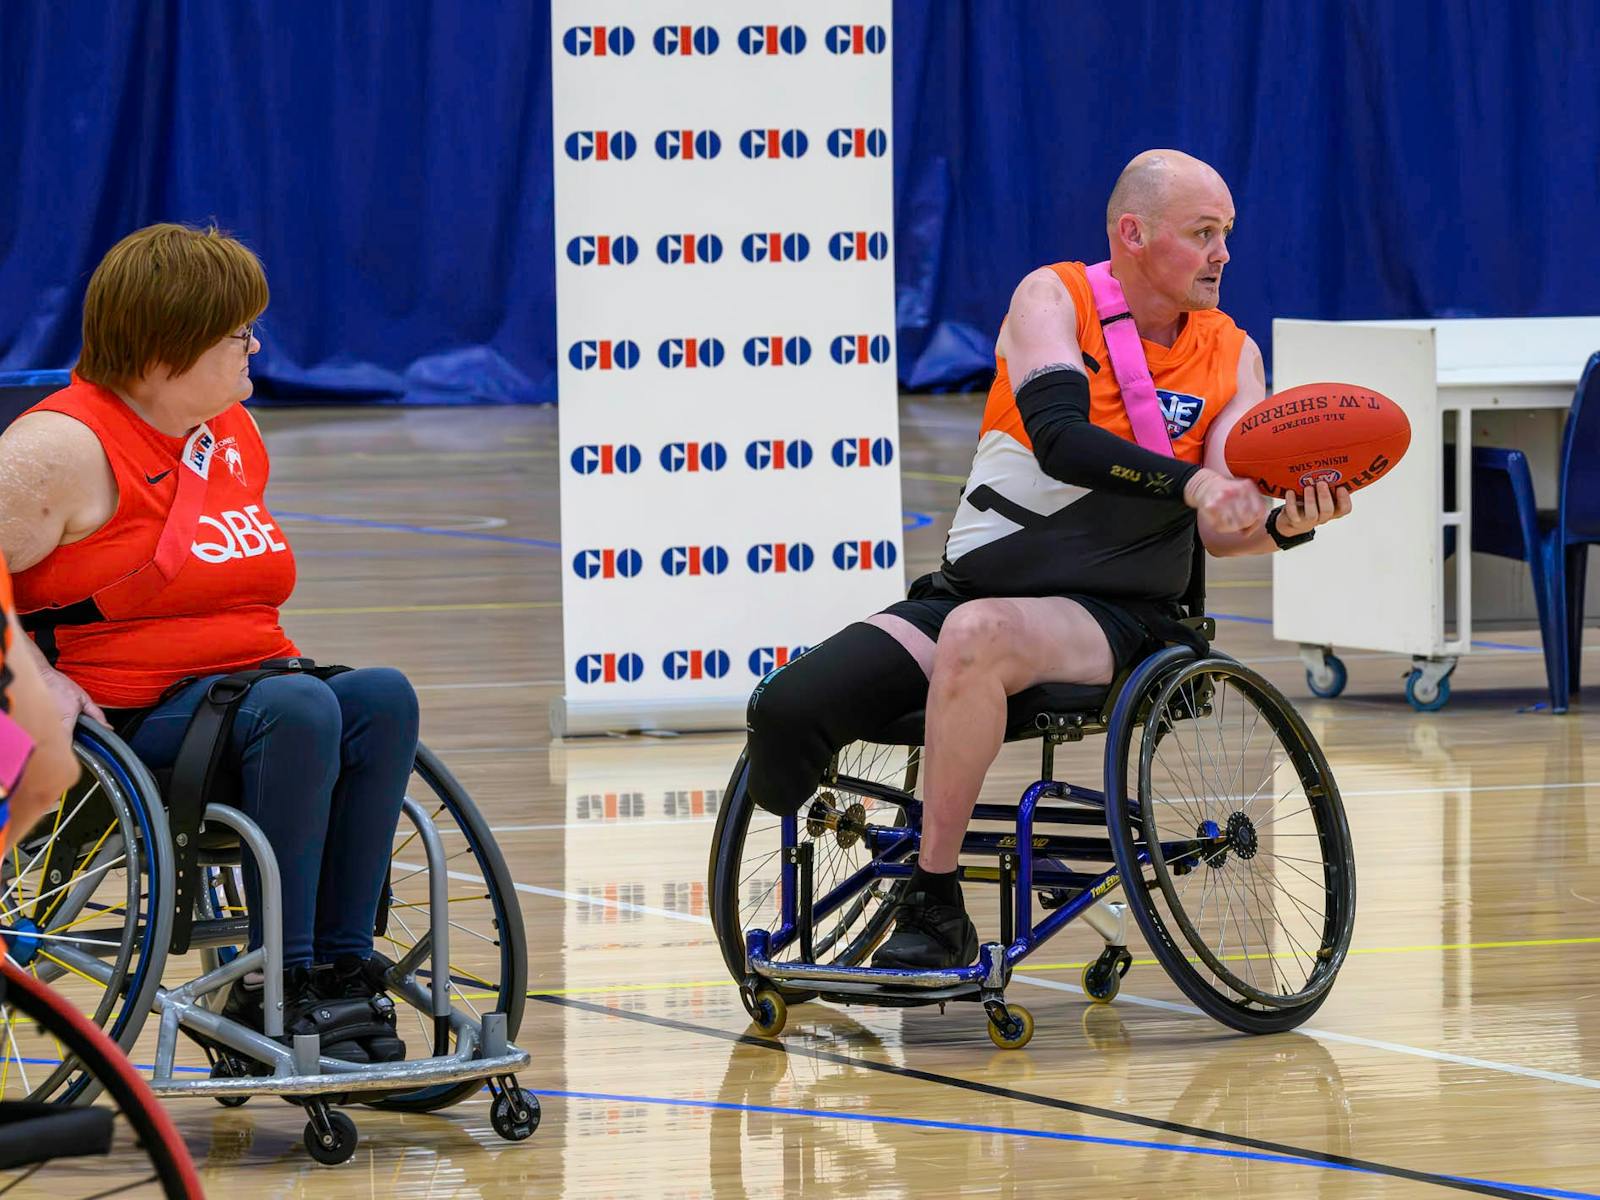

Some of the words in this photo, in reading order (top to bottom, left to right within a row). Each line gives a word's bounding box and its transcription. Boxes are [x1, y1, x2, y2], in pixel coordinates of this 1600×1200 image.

[563, 27, 634, 55] GIO
[654, 27, 718, 55] GIO
[738, 27, 806, 54] GIO
[825, 26, 885, 53] GIO
[565, 132, 636, 160] GIO
[655, 131, 720, 159] GIO
[739, 130, 807, 158] GIO
[827, 129, 886, 157] GIO
[566, 236, 637, 264] GIO
[656, 235, 722, 263] GIO
[741, 234, 809, 261] GIO
[828, 232, 887, 260] GIO
[568, 341, 639, 369] GIO
[658, 339, 724, 367] GIO
[743, 337, 810, 365] GIO
[830, 336, 889, 363] GIO
[1240, 396, 1328, 435] SHERRIN
[1271, 415, 1320, 434] SURFACE
[1323, 412, 1346, 422] ALL
[194, 435, 213, 470] HART
[570, 445, 640, 473] GIO
[660, 443, 726, 471] GIO
[745, 441, 812, 468] GIO
[831, 439, 892, 466] GIO
[1288, 460, 1312, 472] STAR
[1312, 455, 1348, 468] RISING
[1110, 464, 1141, 482] 2XU
[190, 504, 287, 563] QBE
[573, 550, 642, 578] GIO
[661, 547, 728, 575] GIO
[747, 544, 813, 572] GIO
[832, 542, 893, 569] GIO
[575, 654, 643, 682] GIO
[662, 651, 729, 679] GIO
[749, 645, 811, 677] GI
